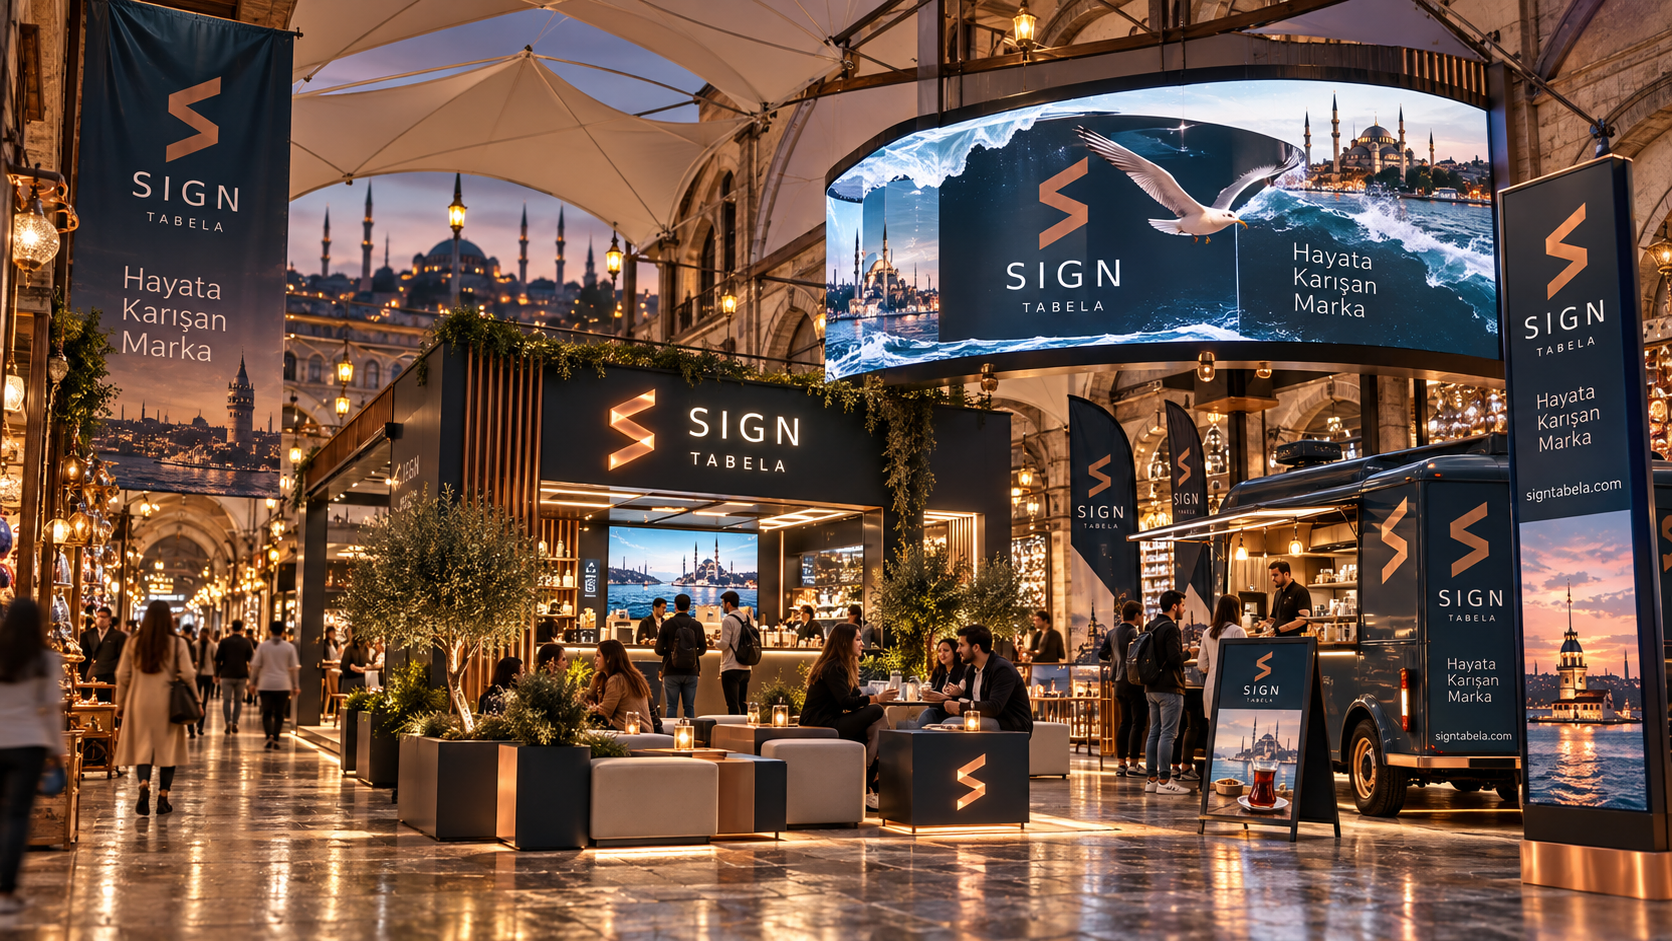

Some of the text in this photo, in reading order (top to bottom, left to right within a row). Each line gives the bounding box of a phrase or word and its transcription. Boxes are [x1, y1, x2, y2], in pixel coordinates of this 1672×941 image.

[132, 170, 239, 213] SIGN
[146, 211, 224, 233] TABELA
[1294, 241, 1372, 270] Hayata
[124, 265, 221, 301] Hayata
[1006, 259, 1120, 291] SIGN
[1294, 266, 1377, 295] Karışan
[123, 297, 226, 333] Karışan
[1022, 300, 1104, 313] TABELA
[1294, 292, 1365, 318] Marka
[1524, 299, 1605, 340] SIGN
[122, 330, 212, 362] Marka
[1536, 336, 1596, 357] TABELA
[1536, 386, 1595, 410] Hayata
[689, 407, 799, 447] SIGN
[1537, 408, 1600, 431] Karışan
[1539, 430, 1592, 453] Marka
[690, 451, 786, 473] TABELA
[1173, 492, 1199, 506] SIGN
[1526, 479, 1622, 503] signtabela.com
[1077, 505, 1124, 519] SIGN
[1083, 522, 1119, 530] TABELA
[1438, 589, 1503, 607] SIGN
[1448, 614, 1496, 623] TABELA
[1447, 657, 1496, 673] Hayata
[1243, 684, 1279, 696] SIGN
[1447, 673, 1499, 689] Karışan
[1448, 689, 1492, 703] Marka
[1435, 730, 1512, 744] signtabela.com
